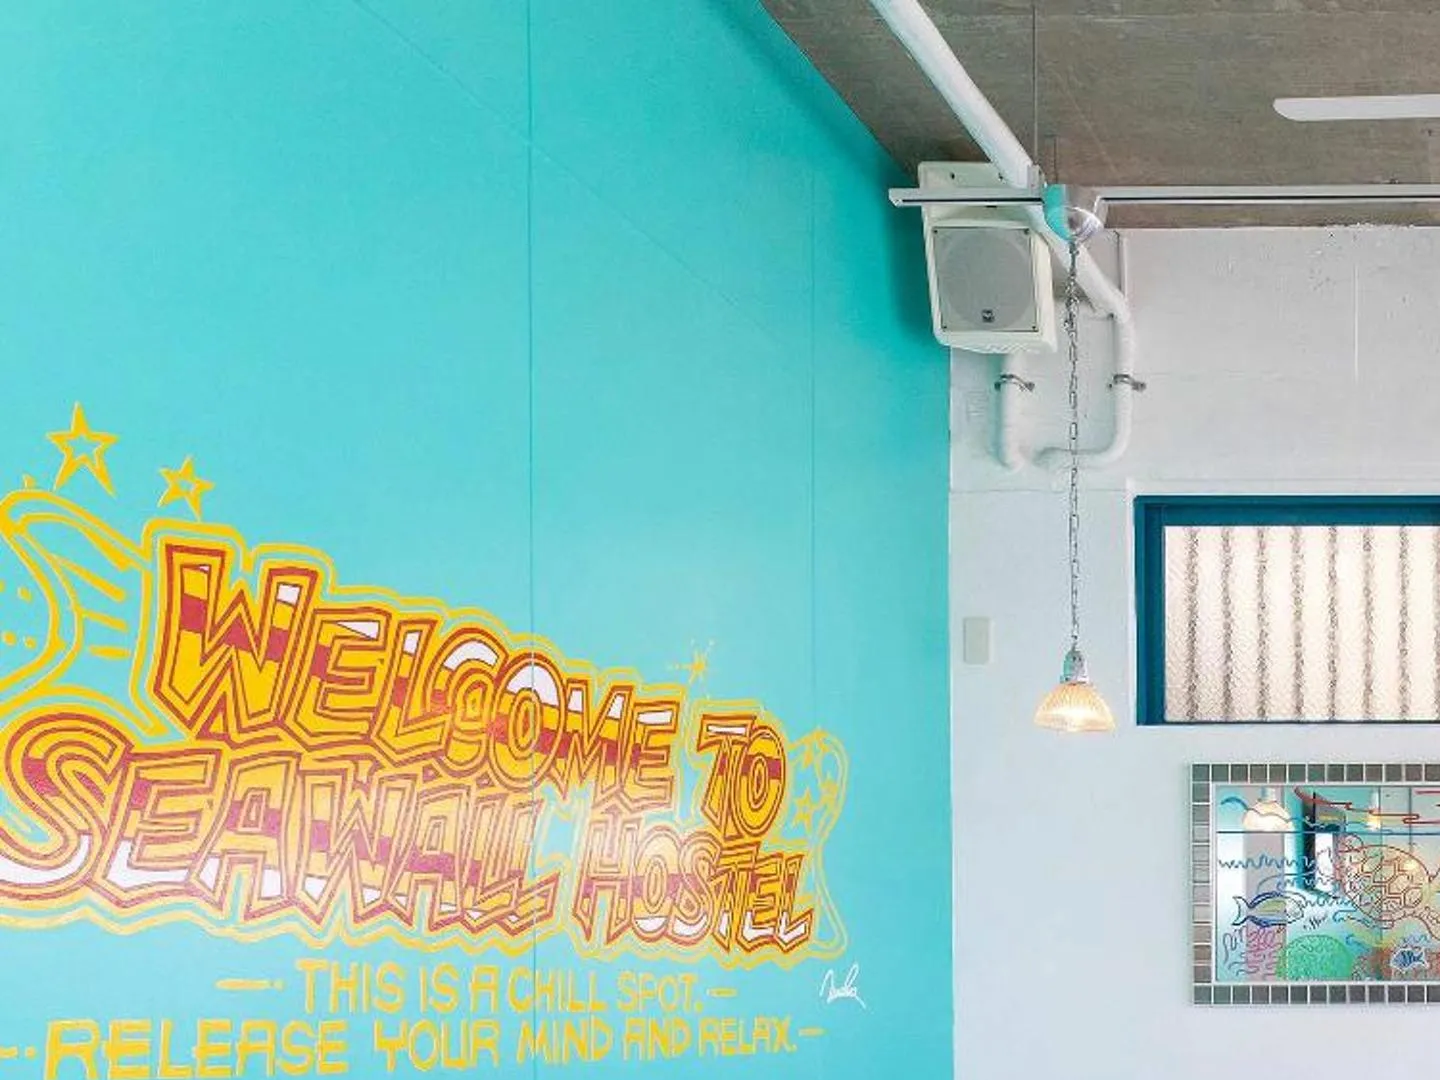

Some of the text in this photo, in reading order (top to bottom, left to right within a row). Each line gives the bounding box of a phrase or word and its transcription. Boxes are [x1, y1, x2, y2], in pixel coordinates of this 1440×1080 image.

[153, 542, 786, 840] WELCOME TO
[0, 712, 813, 953] SEAWALL HOSTEL
[296, 959, 705, 1014] THIS IS A CHILL SPOT.
[373, 1018, 500, 1072] YOUR
[516, 1018, 614, 1066] MIND
[623, 1017, 693, 1062] AND
[699, 1014, 799, 1057] RELAX.
